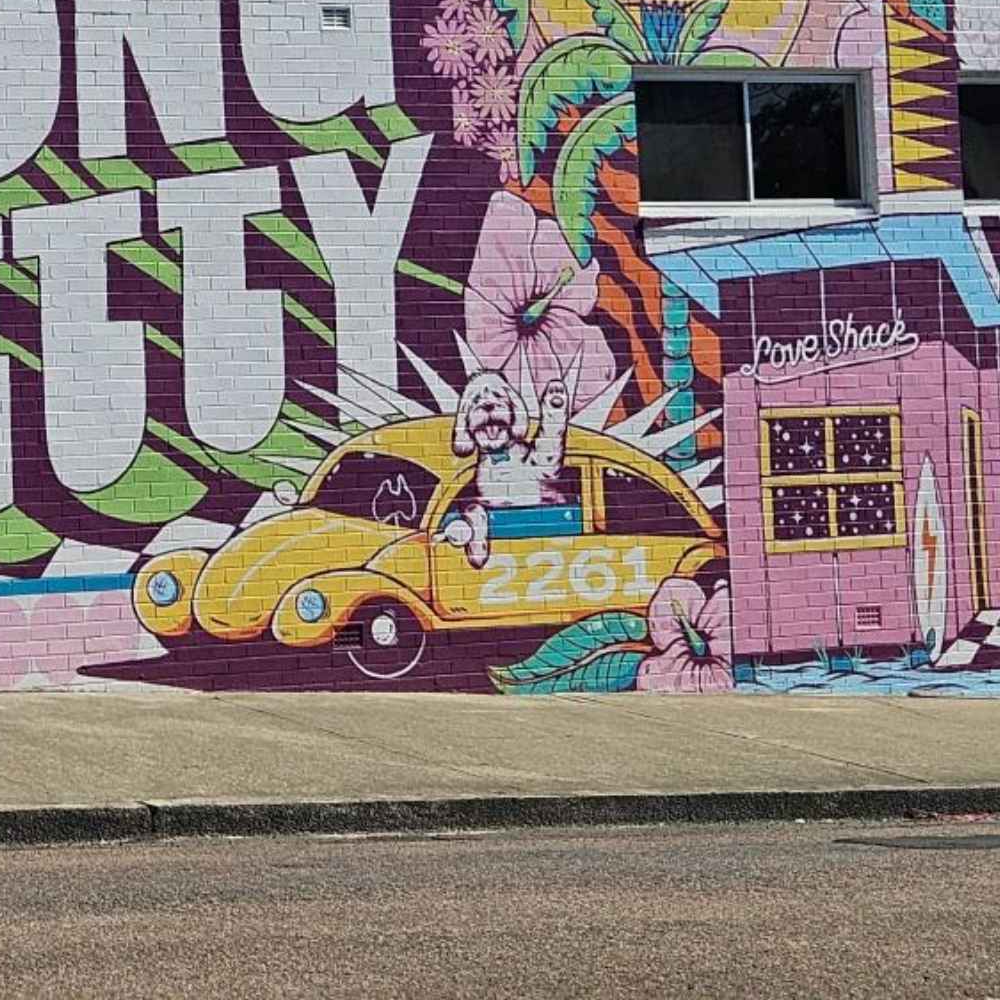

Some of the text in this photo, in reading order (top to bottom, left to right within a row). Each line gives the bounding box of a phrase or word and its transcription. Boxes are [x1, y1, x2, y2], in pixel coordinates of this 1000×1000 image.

[740, 309, 919, 376] Love Shack
[479, 547, 655, 605] 2261
